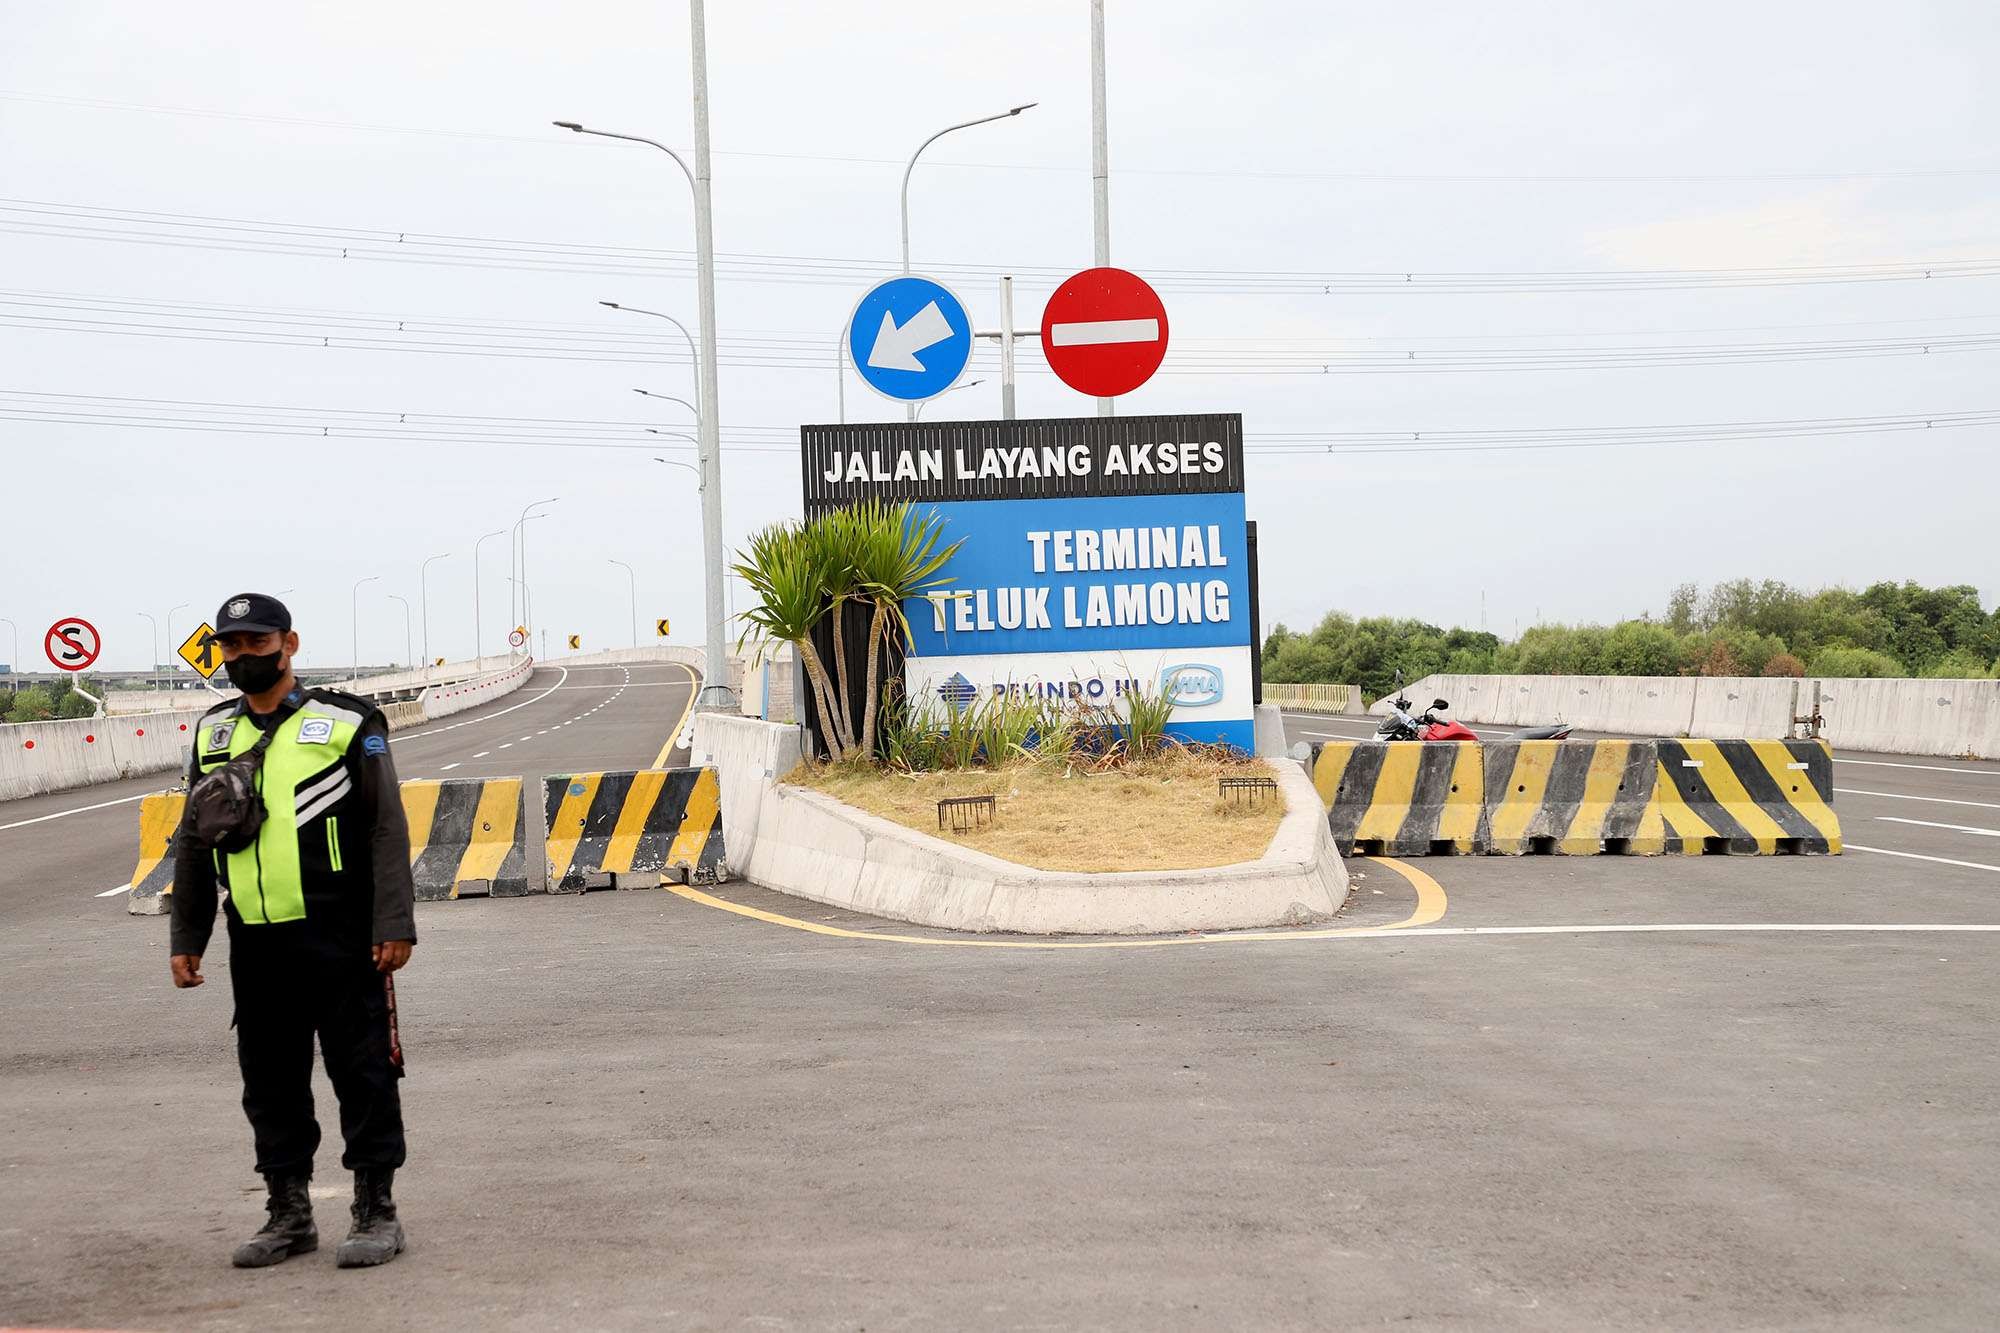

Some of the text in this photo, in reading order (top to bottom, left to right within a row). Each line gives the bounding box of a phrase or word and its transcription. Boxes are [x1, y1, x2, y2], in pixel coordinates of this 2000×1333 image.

[824, 441, 1224, 483] JALAN LAYANG AKSES
[1026, 525, 1228, 573] TERMINAL
[927, 580, 1230, 632] TELUK LAMONG
